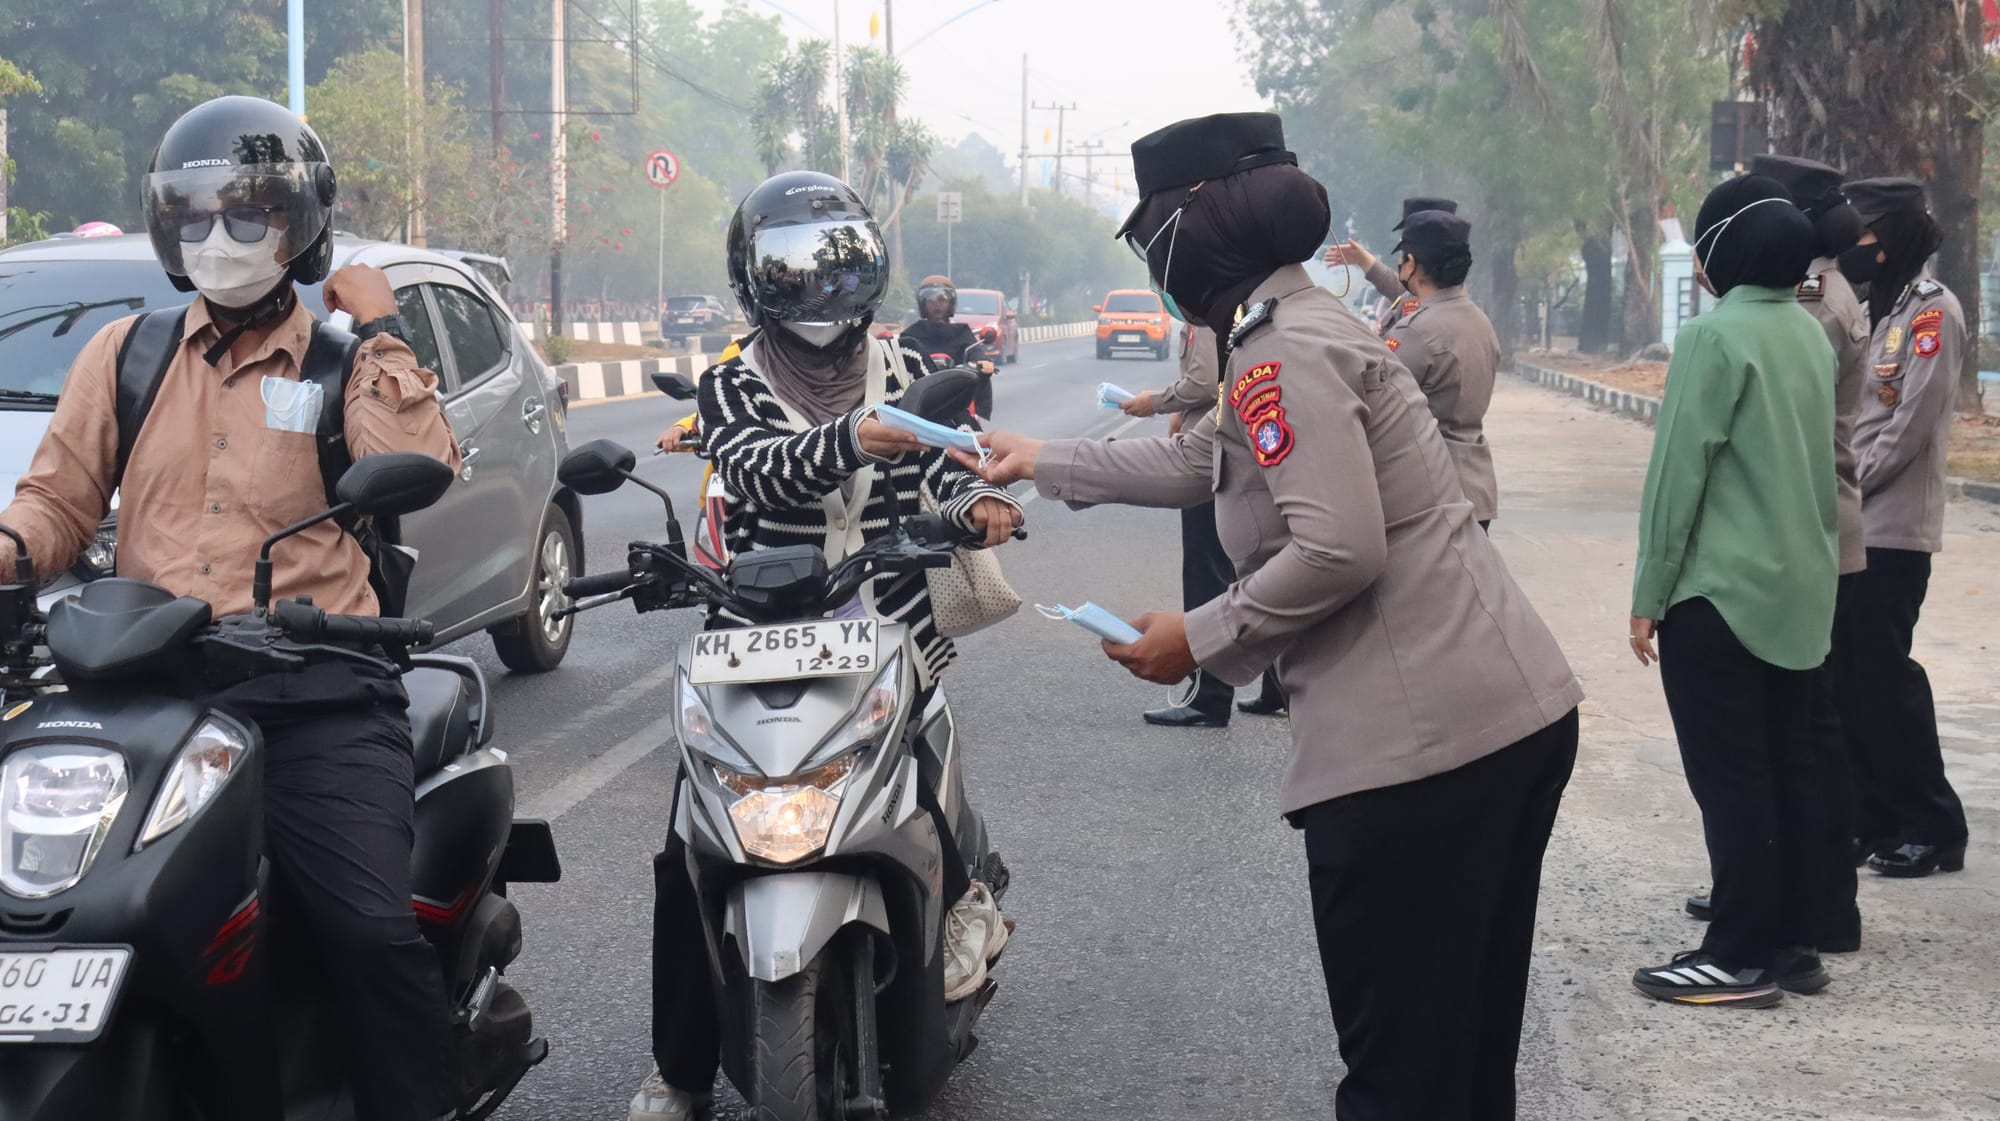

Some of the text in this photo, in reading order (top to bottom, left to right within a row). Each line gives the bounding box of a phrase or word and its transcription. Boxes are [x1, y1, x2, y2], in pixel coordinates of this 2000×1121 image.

[182, 158, 232, 169] HONDA
[1233, 365, 1273, 400] POLDA
[695, 620, 873, 656] KH 2665 YK
[36, 721, 103, 730] HONDA
[756, 716, 803, 726] HONDA
[881, 783, 903, 824] HONDA
[0, 958, 114, 988] 60 VA
